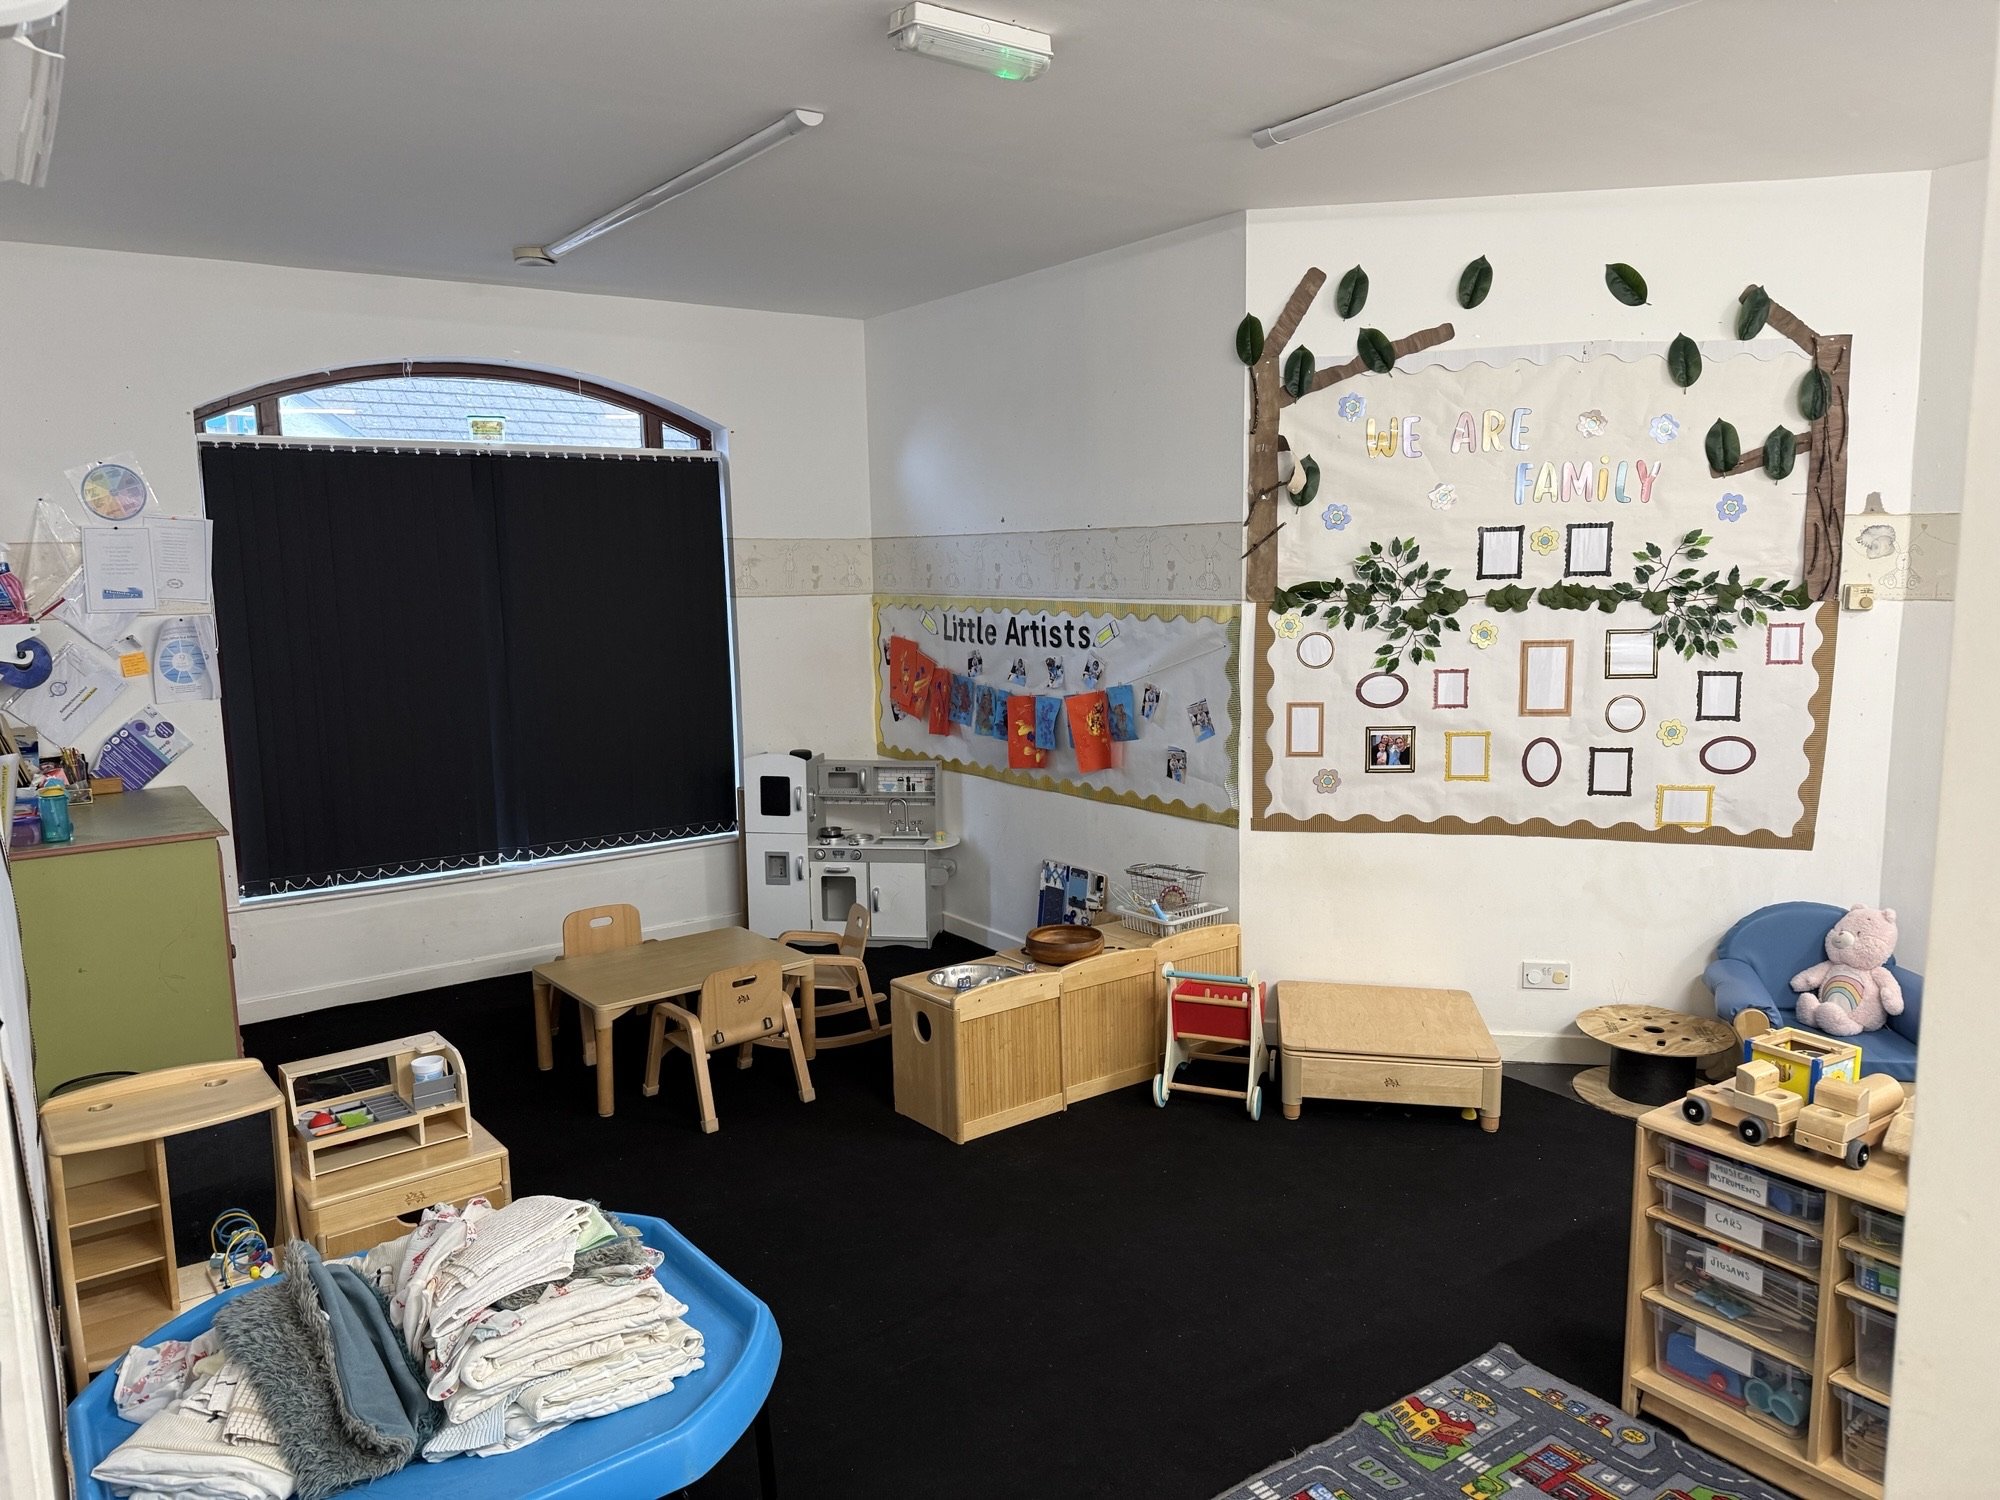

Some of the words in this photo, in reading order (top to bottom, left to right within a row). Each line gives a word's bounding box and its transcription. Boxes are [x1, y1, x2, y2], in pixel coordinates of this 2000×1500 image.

[1366, 416, 1423, 459] WE
[1451, 407, 1533, 454] ARE
[943, 613, 998, 646] Little
[1004, 615, 1092, 650] Artists
[1710, 1172, 1761, 1198] INSTRUMENTS
[1715, 1164, 1754, 1183] MUSICAL
[1715, 1212, 1742, 1231] CARS
[1710, 1256, 1750, 1280] JIGSAWS
